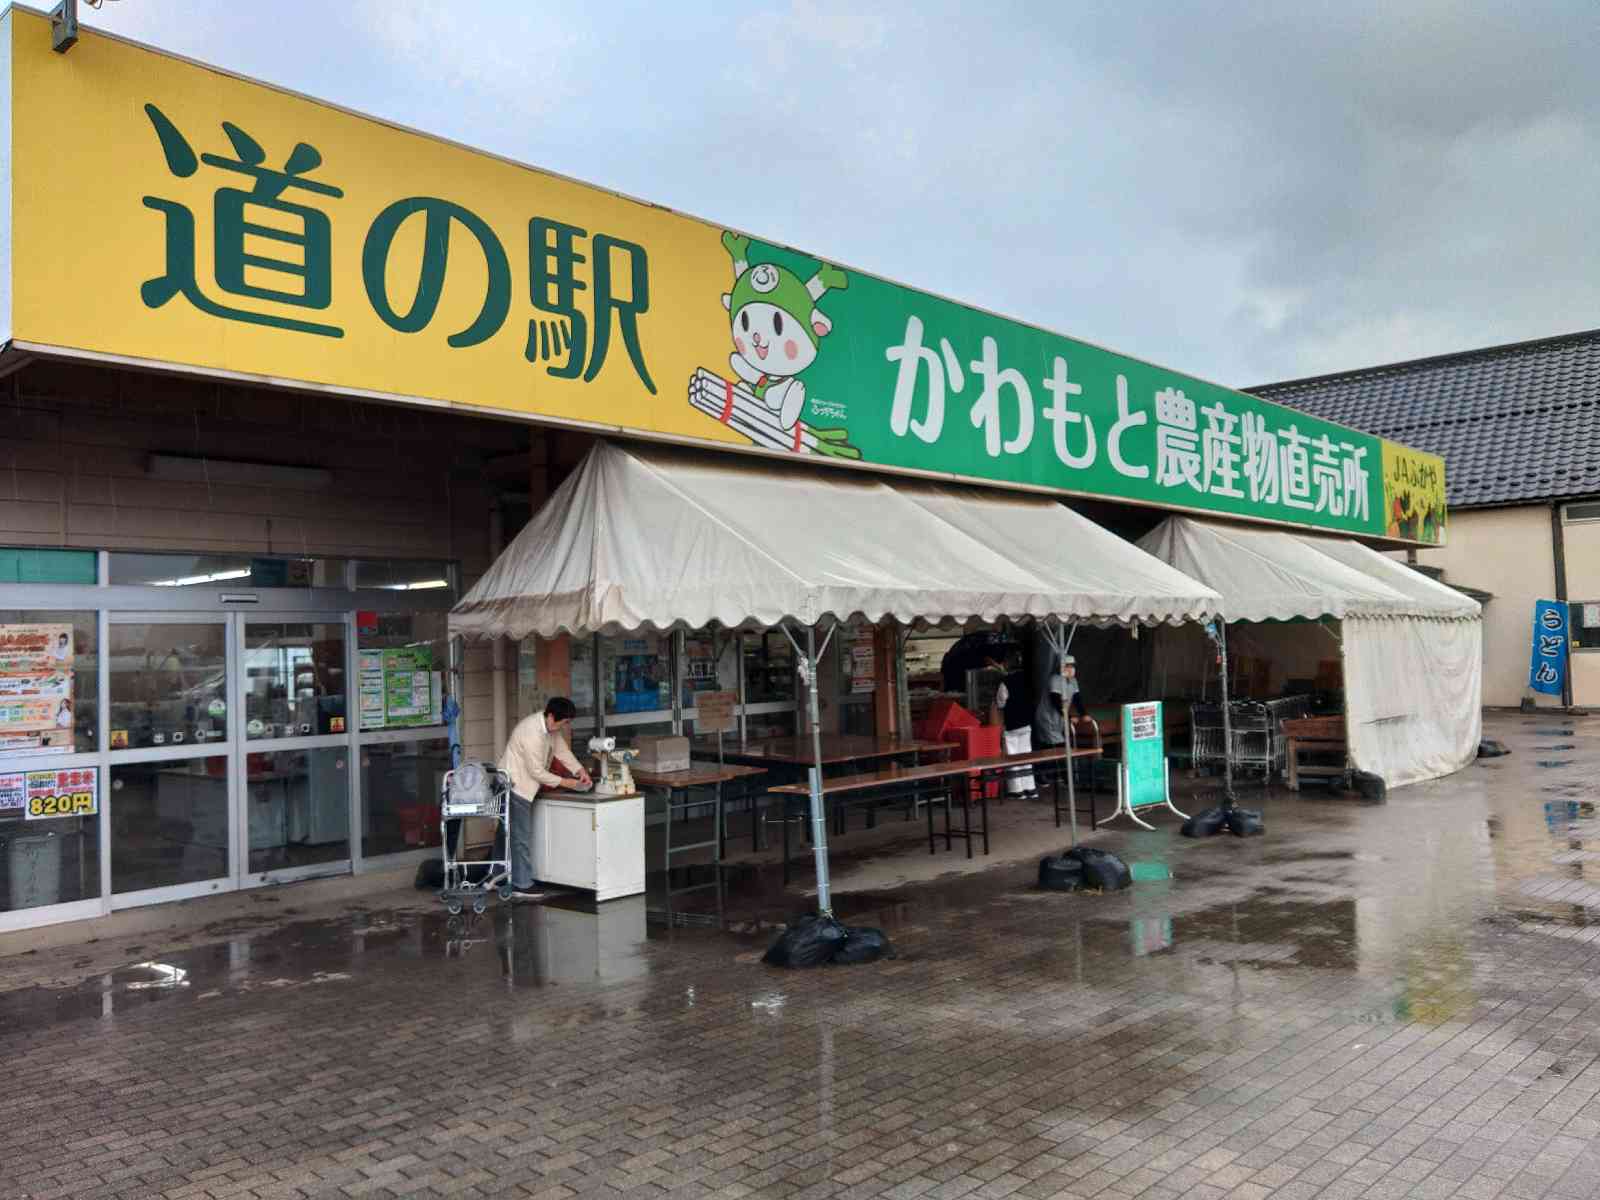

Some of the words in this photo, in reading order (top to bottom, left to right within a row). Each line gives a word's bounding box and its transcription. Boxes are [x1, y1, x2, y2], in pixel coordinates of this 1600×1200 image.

[140, 103, 658, 396] 道の駅
[885, 315, 1371, 522] かわもと農産物直売所
[1535, 608, 1564, 684] うどん
[29, 791, 94, 816] 820円
